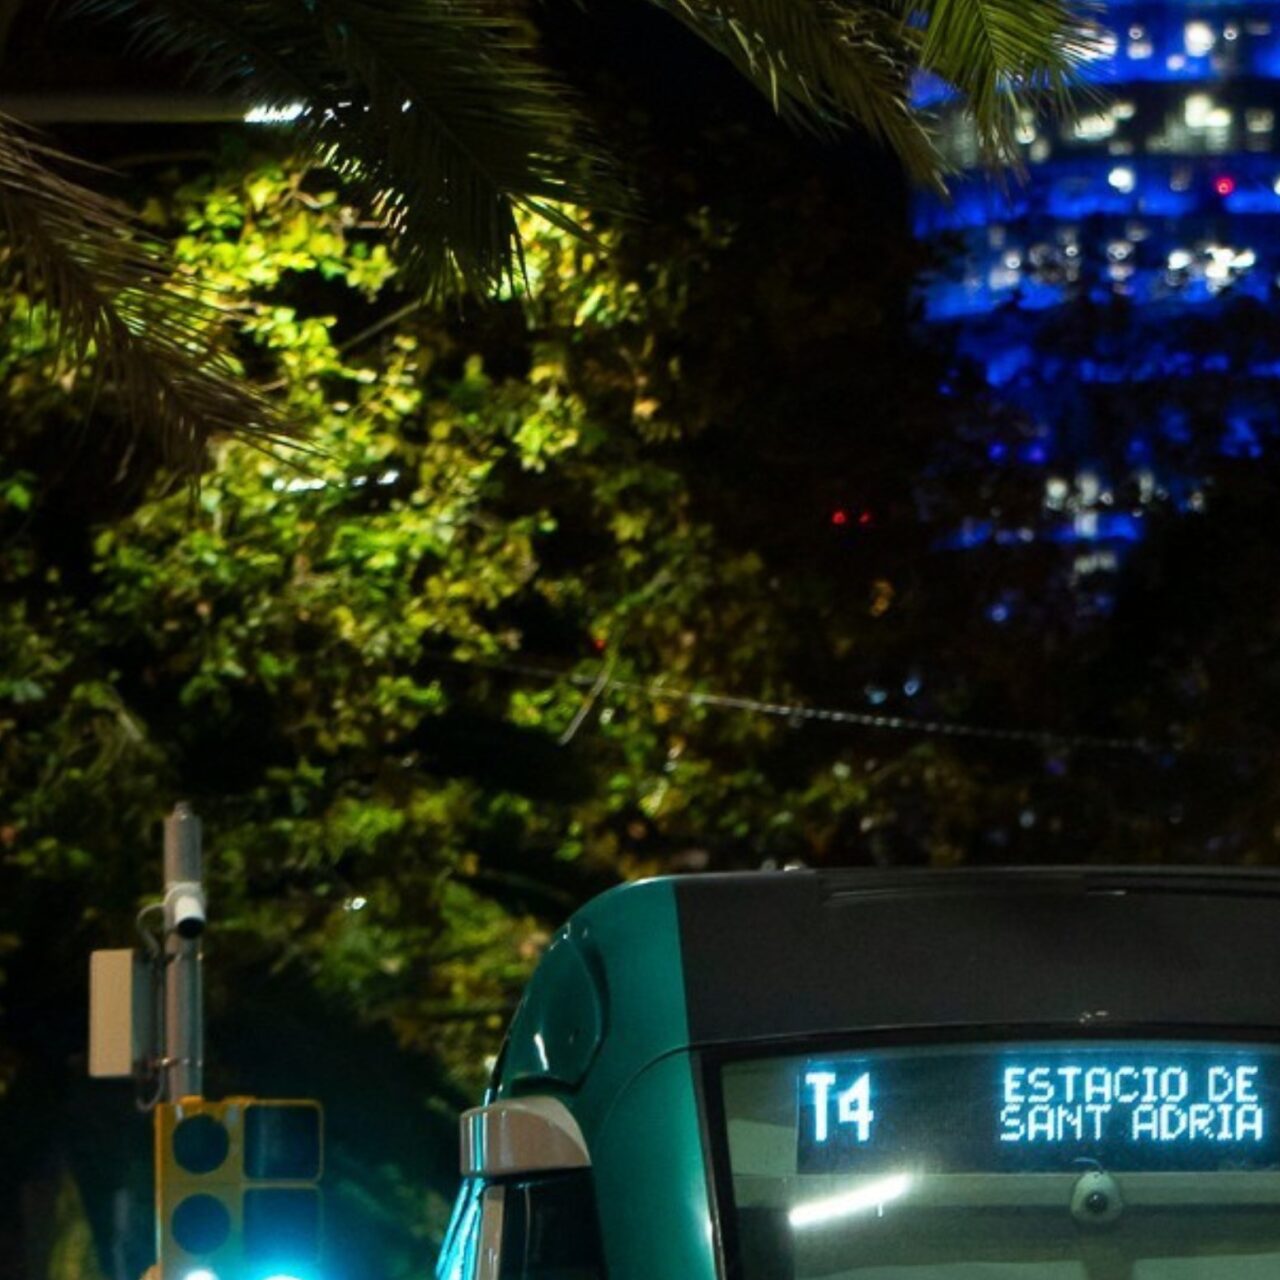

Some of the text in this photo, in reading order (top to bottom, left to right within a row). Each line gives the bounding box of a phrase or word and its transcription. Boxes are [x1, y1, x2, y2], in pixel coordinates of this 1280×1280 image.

[1003, 1066, 1259, 1103] ESTACIO DE
[806, 1071, 874, 1142] T4
[999, 1104, 1264, 1141] SANT ADRIA
